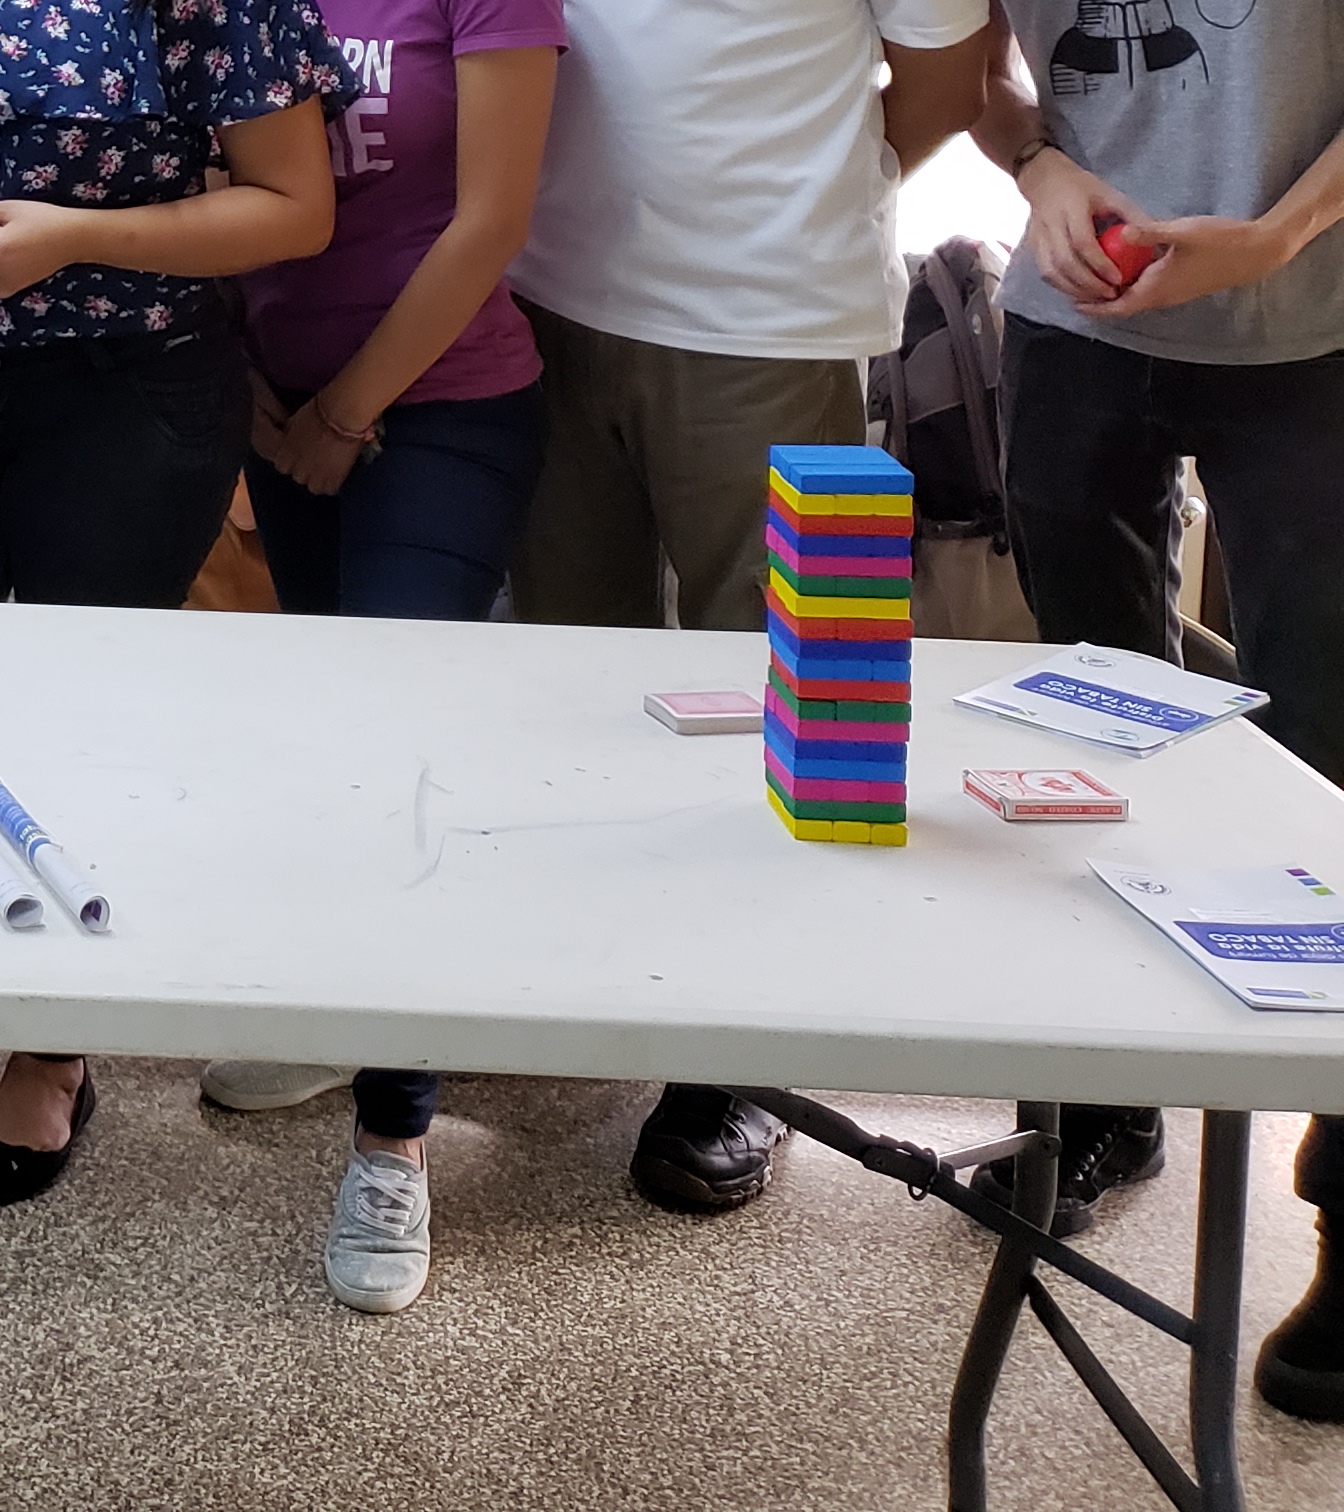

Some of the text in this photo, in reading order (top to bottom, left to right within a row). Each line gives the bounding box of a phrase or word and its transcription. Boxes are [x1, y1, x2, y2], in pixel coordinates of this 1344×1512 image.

[1039, 683, 1075, 697] vida
[1047, 680, 1153, 713] SIN TABACO
[1208, 932, 1335, 945] SIN TABACO
[1217, 941, 1263, 952] vida
